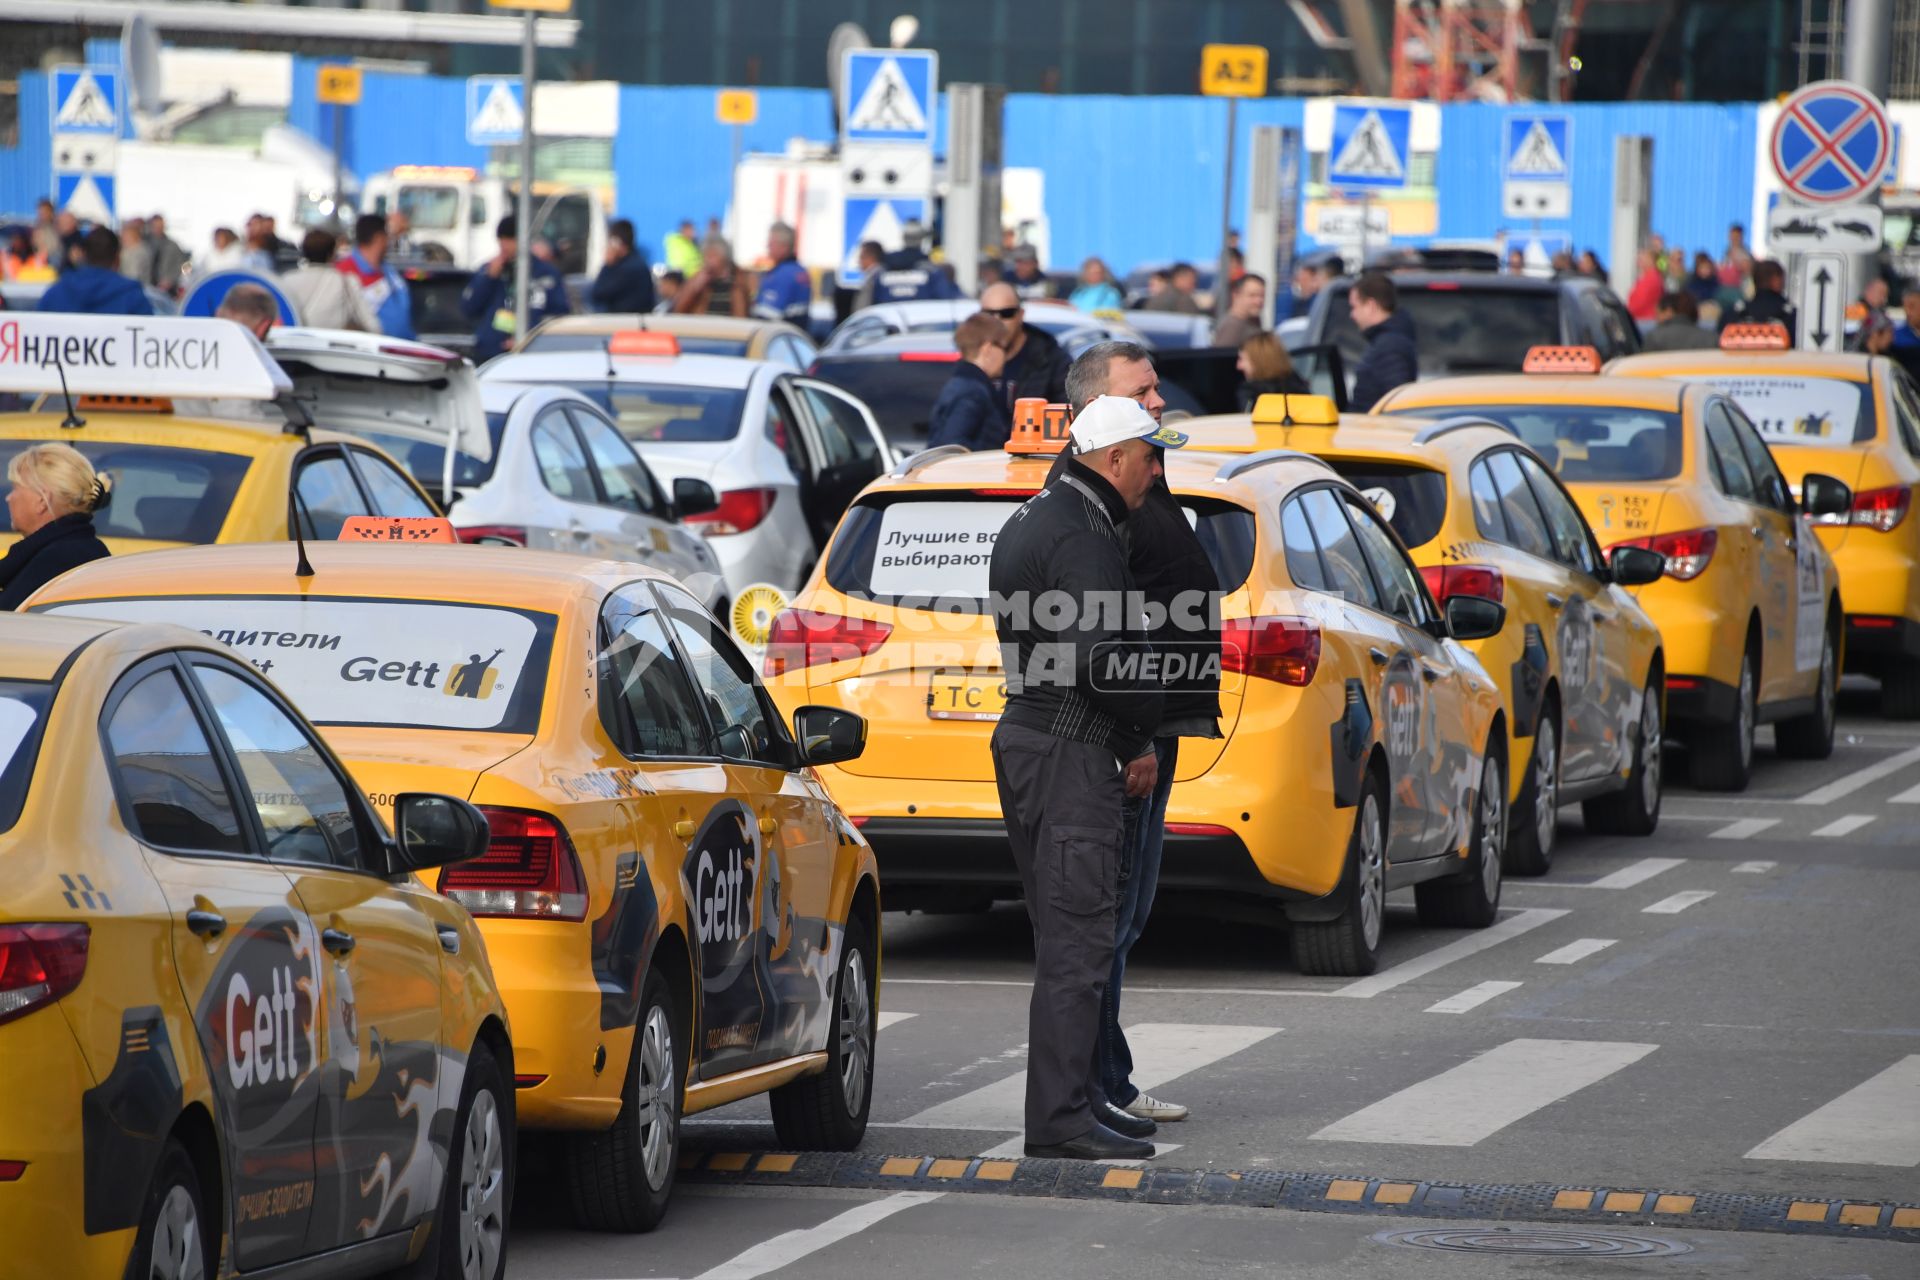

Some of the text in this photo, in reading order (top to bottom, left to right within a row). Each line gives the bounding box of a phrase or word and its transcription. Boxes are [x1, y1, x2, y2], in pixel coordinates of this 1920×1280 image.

[0, 320, 219, 370] Яндекс Такси
[881, 551, 992, 569] выбирают
[884, 531, 970, 548] Лучшие
[340, 656, 440, 689] Gett
[696, 847, 743, 944] Gett
[226, 965, 298, 1090] Gett
